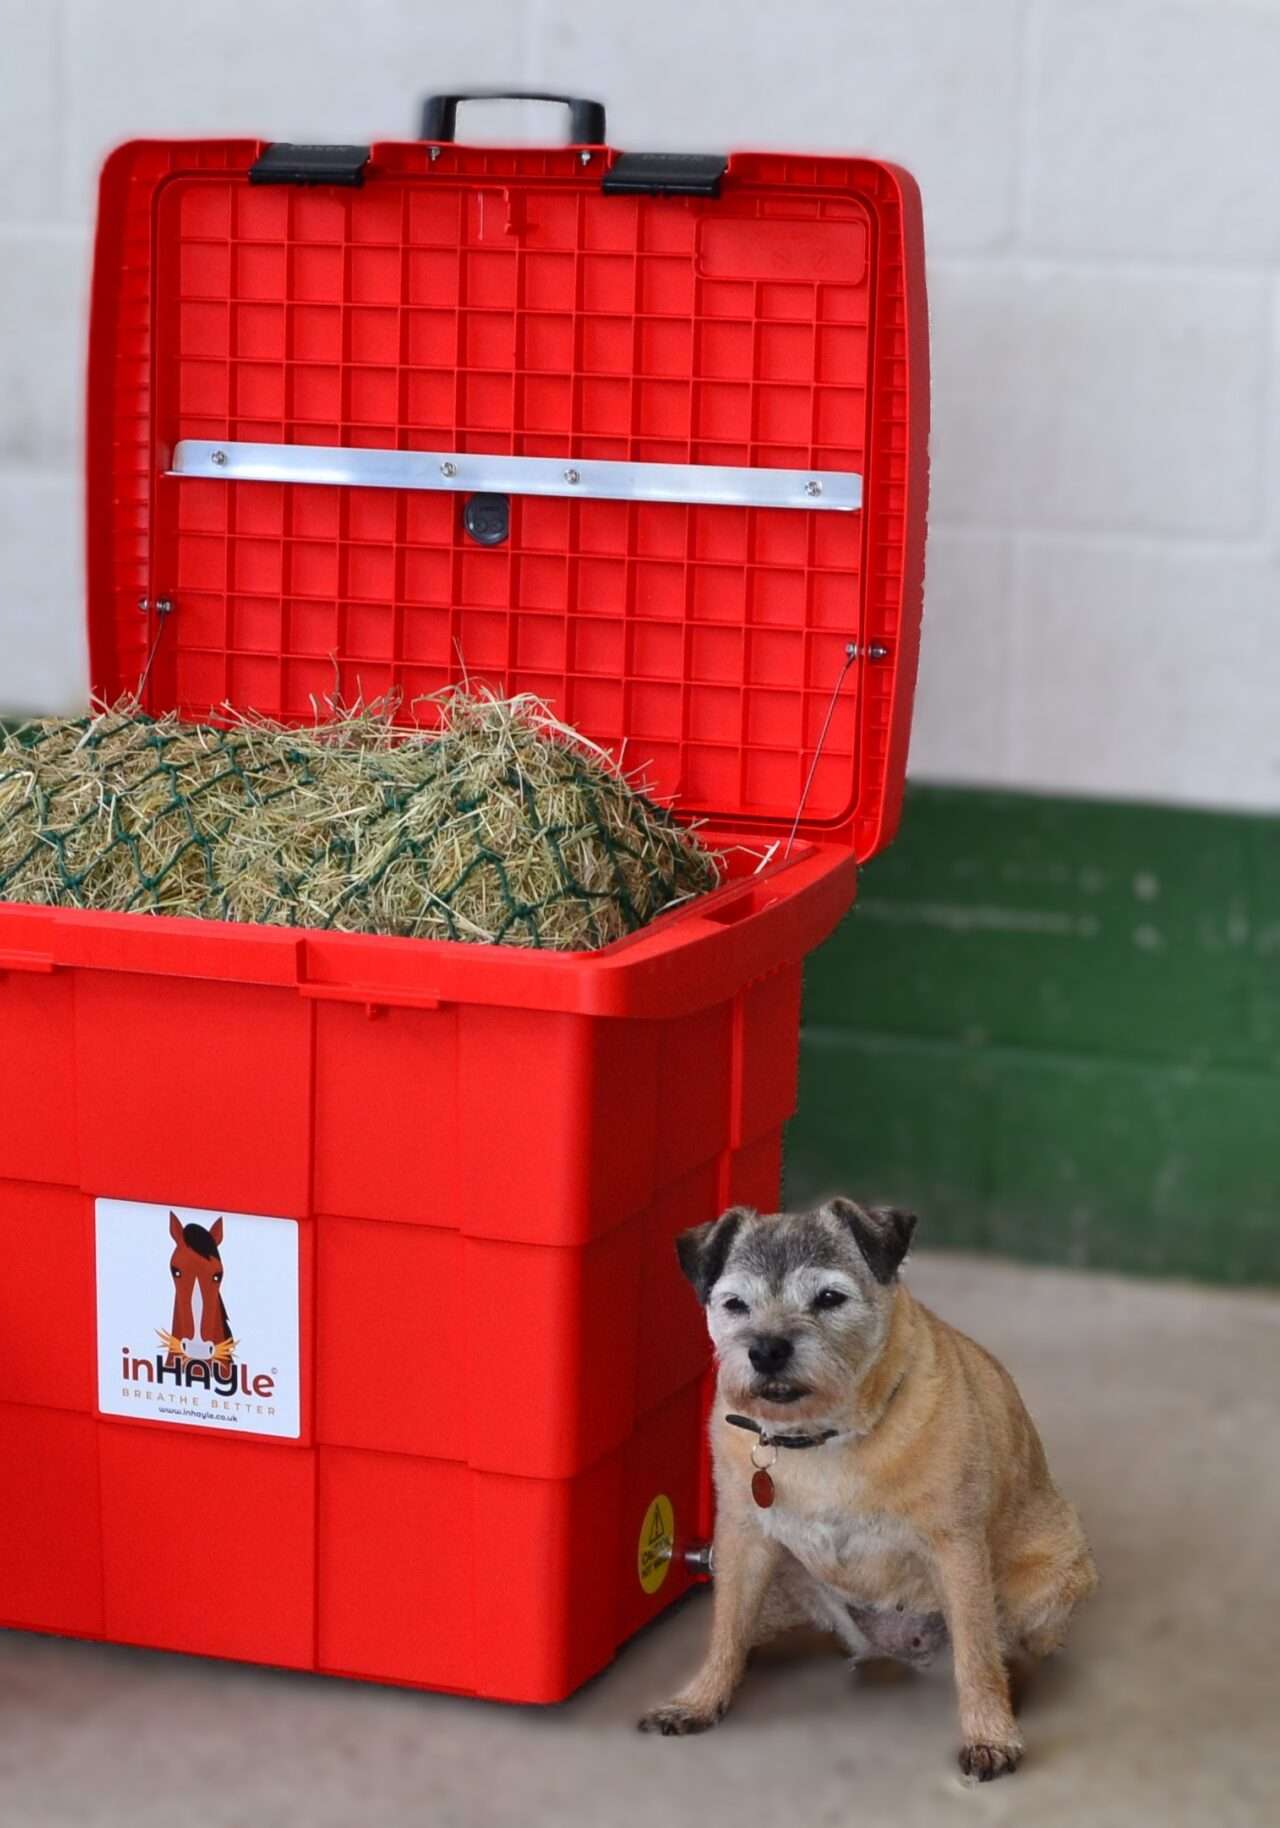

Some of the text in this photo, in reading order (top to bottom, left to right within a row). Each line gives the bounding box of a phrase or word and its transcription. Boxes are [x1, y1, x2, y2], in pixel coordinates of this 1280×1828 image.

[122, 1387, 276, 1416] BREATHE BETTER
[158, 1406, 238, 1422] www.inhayle.co.uk
